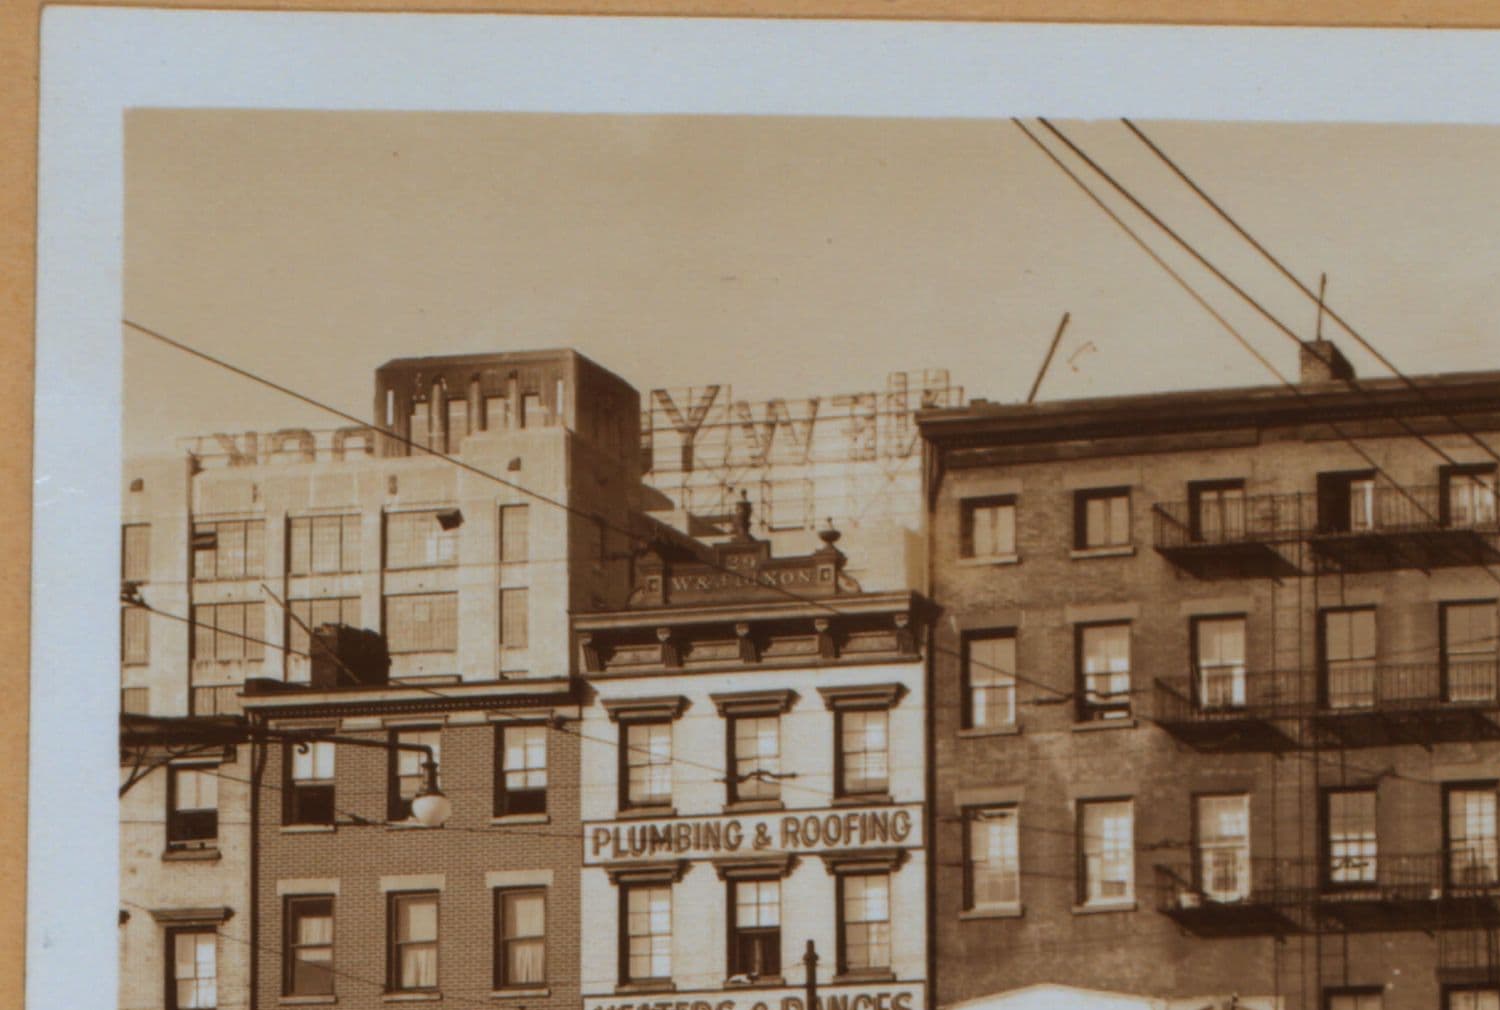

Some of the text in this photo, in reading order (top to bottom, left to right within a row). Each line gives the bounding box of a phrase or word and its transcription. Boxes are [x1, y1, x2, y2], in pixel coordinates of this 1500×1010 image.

[591, 809, 913, 858] PLUMBING & ROOFING
